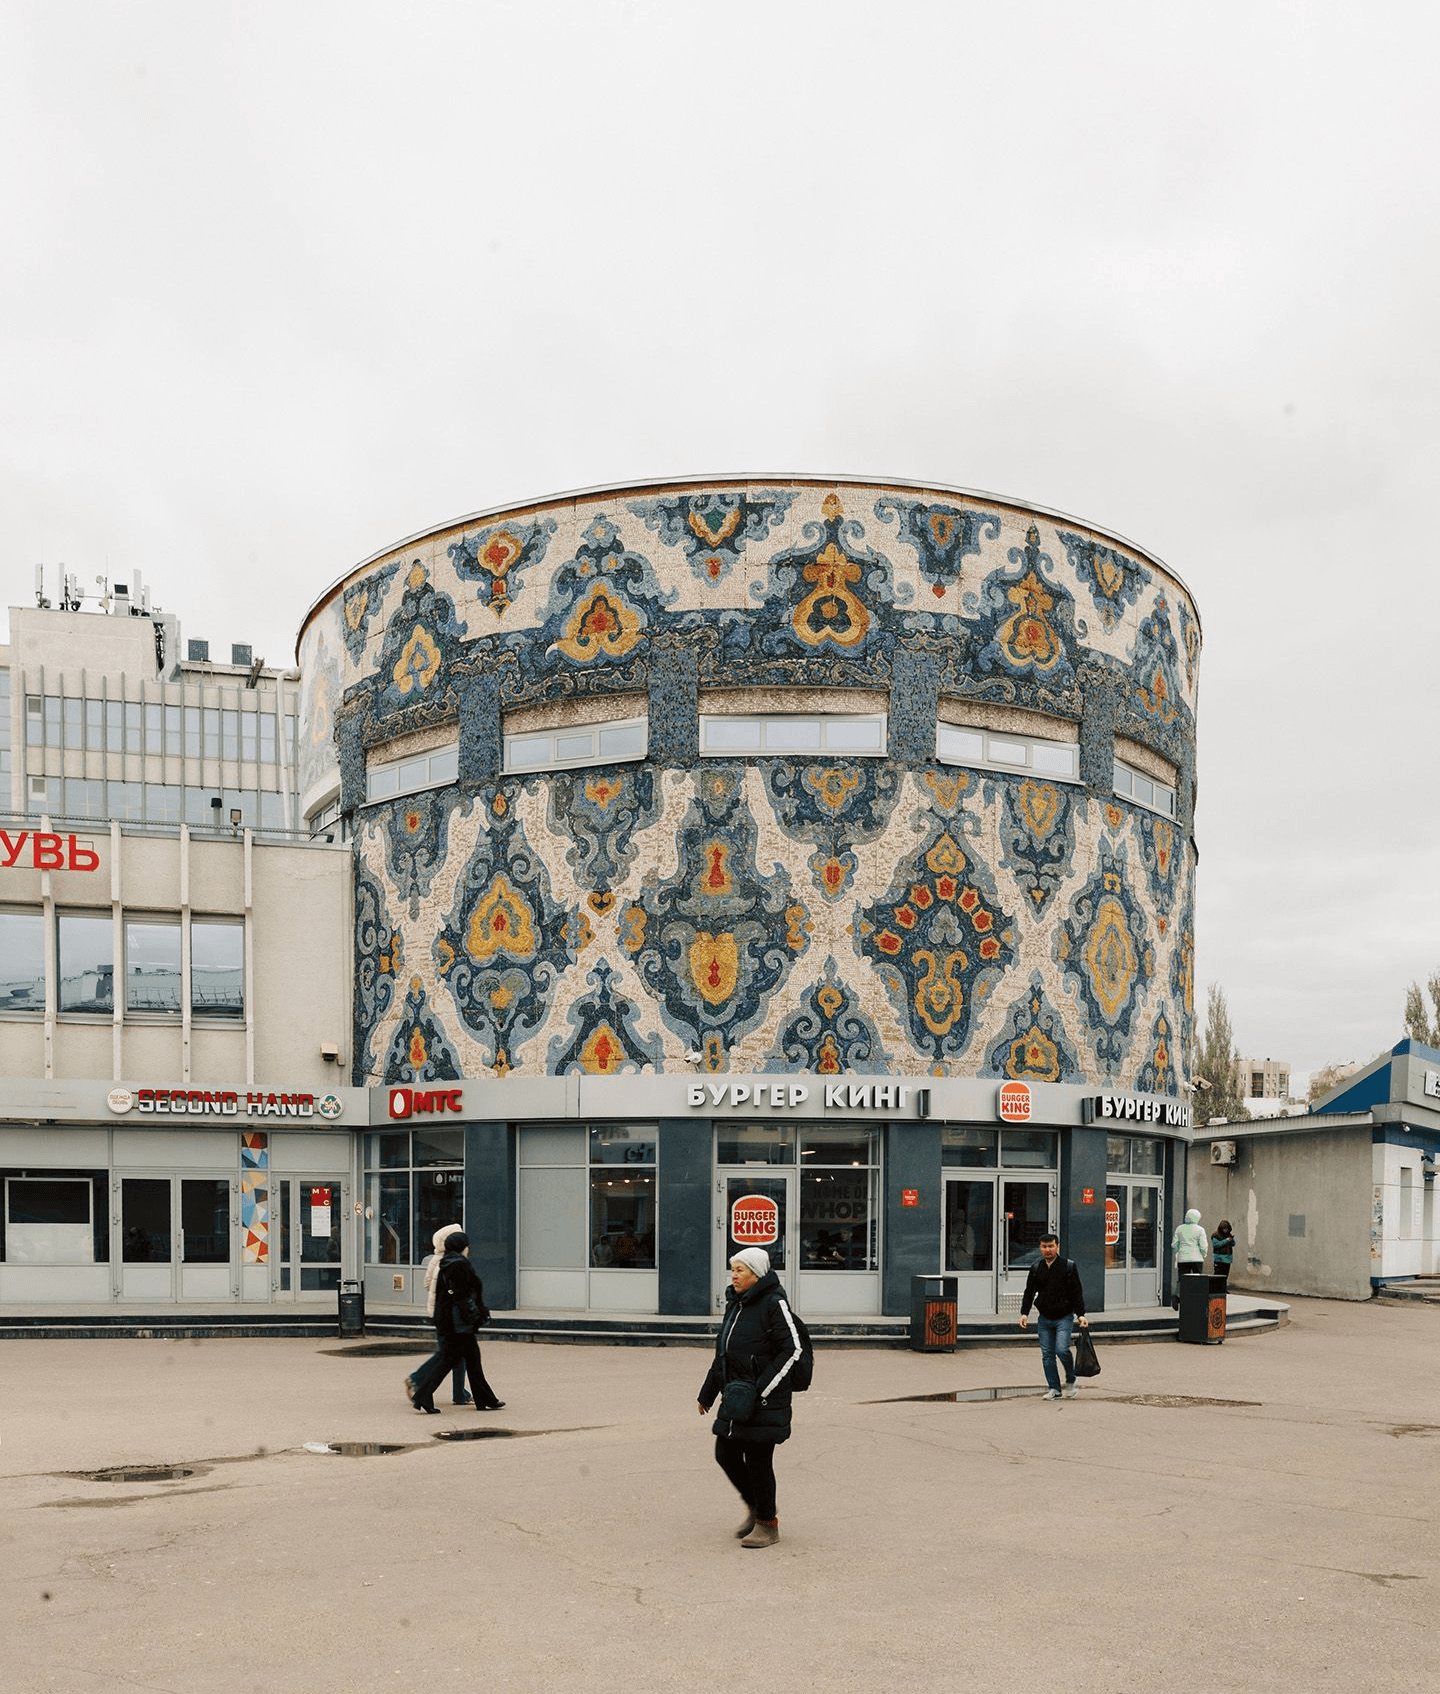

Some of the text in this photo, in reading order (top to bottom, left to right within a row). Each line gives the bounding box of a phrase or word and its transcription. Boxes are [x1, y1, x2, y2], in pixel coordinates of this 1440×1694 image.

[0, 830, 99, 871] УВЬ
[138, 1089, 314, 1117] SECOND HAND
[413, 1089, 463, 1113] МТС
[687, 1082, 913, 1108] БУРГЕР КИНГ
[1001, 1094, 1030, 1102] BURGER
[1001, 1102, 1030, 1113] KING
[1101, 1095, 1161, 1122] БУРГЕР
[734, 1211, 776, 1221] BURGER
[734, 1221, 776, 1234] KING
